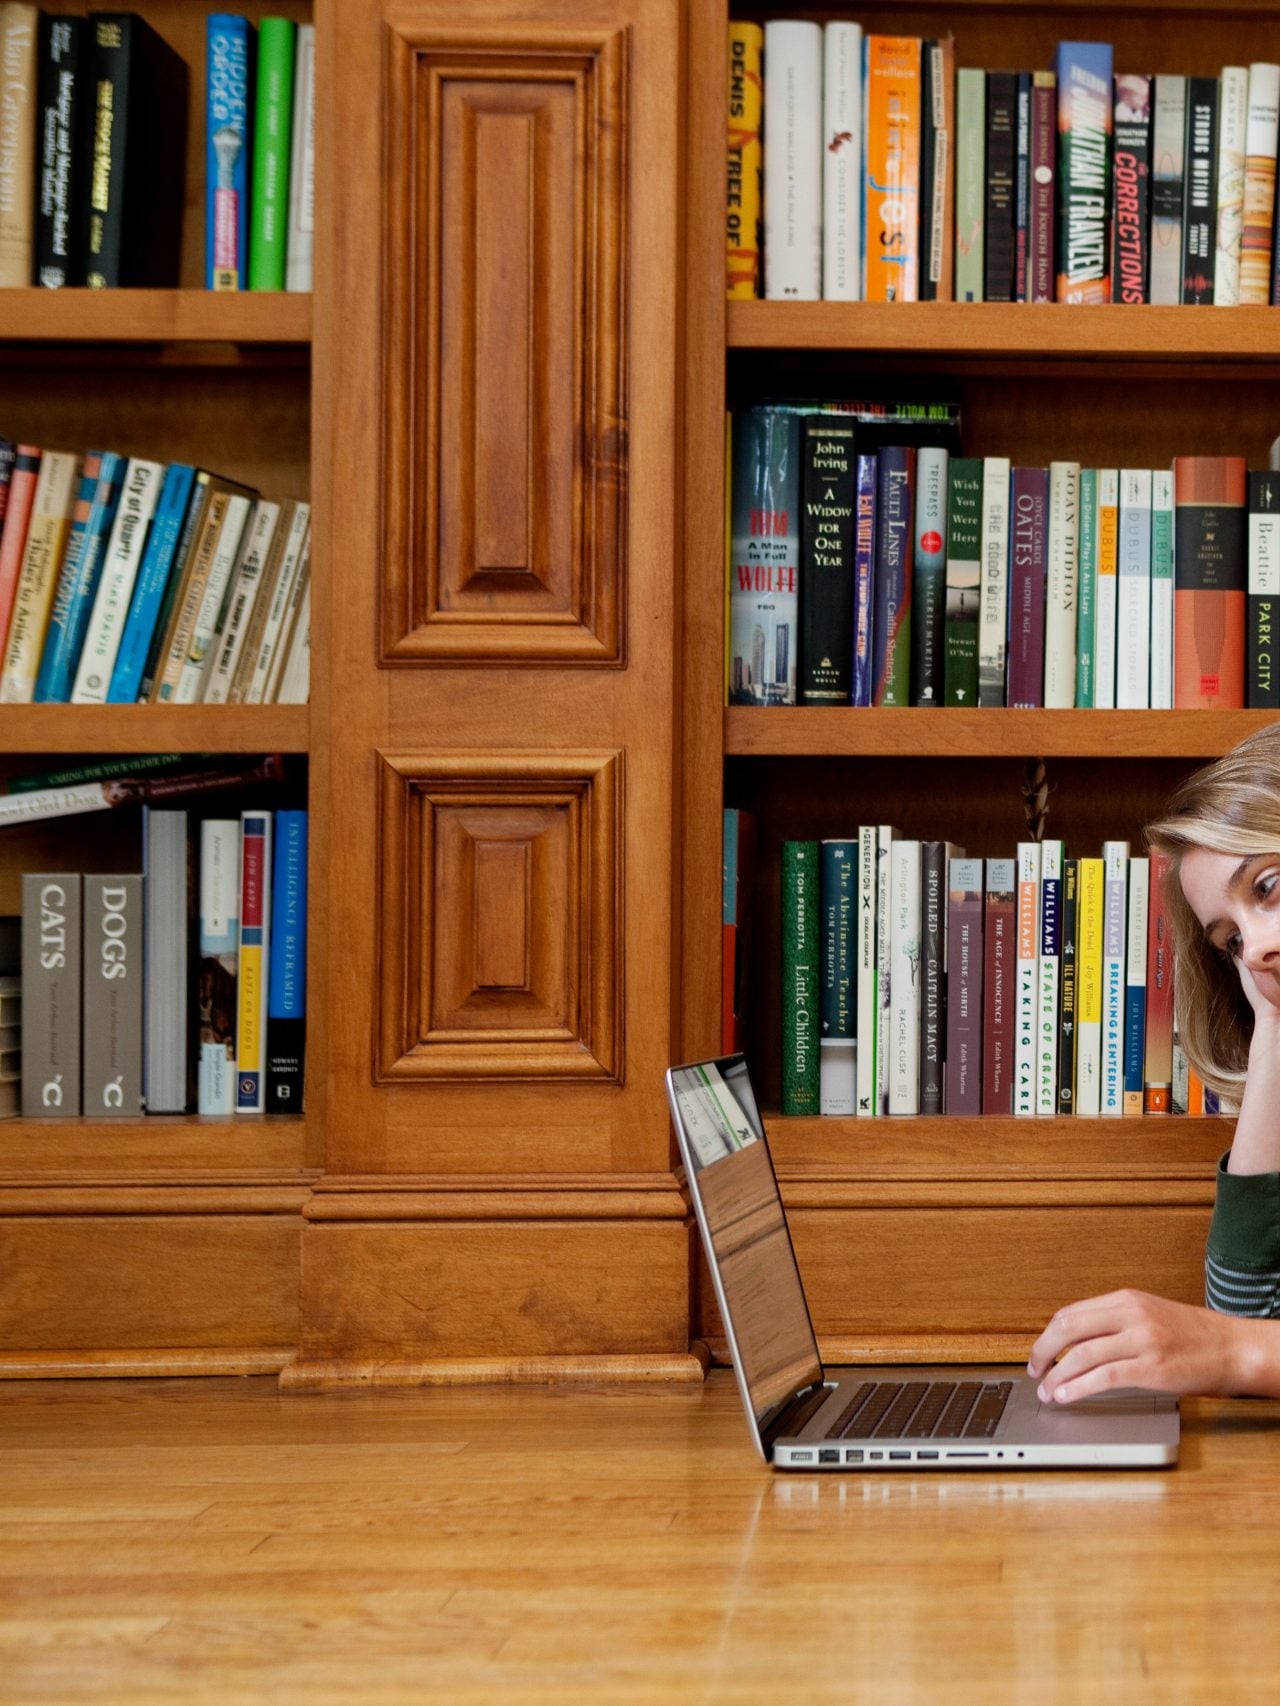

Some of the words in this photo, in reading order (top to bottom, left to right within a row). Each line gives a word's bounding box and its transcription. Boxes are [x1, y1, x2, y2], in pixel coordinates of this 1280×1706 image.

[731, 40, 745, 117] DENIS
[1038, 92, 1049, 123] JOHN
[1194, 105, 1210, 152] STRONG
[1039, 125, 1049, 163] IRVING
[1069, 87, 1106, 189] JONATHAN
[728, 147, 742, 207] TREE
[1038, 188, 1048, 207] THE
[1192, 159, 1209, 207] MOTION
[727, 214, 742, 247] OF
[1038, 212, 1048, 253] FOURTH
[1068, 195, 1104, 284] FRANZEN
[1116, 153, 1143, 304] CORRECTIONS
[1199, 223, 1208, 257] JONATHAN
[1038, 257, 1047, 290] HAND
[813, 457, 848, 472] Irving
[816, 442, 844, 454] John
[130, 467, 151, 493] City
[824, 489, 835, 500] A
[888, 470, 907, 517] FAULT
[927, 464, 939, 517] TRESPASS
[953, 480, 979, 490] Wish
[955, 497, 975, 507] You
[1065, 470, 1075, 524] JOAN
[129, 499, 143, 512] of
[807, 504, 852, 517] WIDOW
[953, 515, 978, 525] Were
[116, 515, 138, 559] Quartz
[814, 538, 842, 550] ONE
[818, 524, 840, 533] FOR
[887, 520, 906, 566] LINES
[952, 532, 978, 542] Here
[1016, 494, 1033, 566] OATES
[1101, 510, 1112, 574] DUBUS
[1129, 513, 1140, 573] DUBUS
[1156, 515, 1168, 574] DUBUS
[814, 554, 842, 567] YEAR
[1064, 536, 1074, 612] DIDION
[1258, 523, 1272, 588] Beattie
[52, 531, 84, 627] PHILOSOPHY
[109, 573, 124, 607] MIKE
[737, 566, 796, 592] WOLFE
[96, 614, 115, 655] DAVIS
[886, 601, 897, 635] Caitlin
[1258, 603, 1271, 644] PARK
[885, 639, 897, 686] Shetterly
[1258, 653, 1271, 691] CITY
[797, 872, 805, 894] TOM
[839, 863, 850, 889] The
[928, 870, 937, 932] SPOILED
[1023, 885, 1032, 958] WILLIAMS
[1045, 882, 1055, 954] WILLIAMS
[1109, 882, 1119, 954] WILLIAMS
[41, 884, 65, 969] CATS
[102, 886, 127, 979] DOGS
[797, 898, 805, 950] PERROTTA
[839, 895, 849, 970] Abstinence
[995, 918, 1003, 937] THE
[827, 932, 835, 988] PERROTTA
[1064, 964, 1073, 978] ILL
[1085, 965, 1093, 979] Joy
[795, 965, 810, 1005] Little
[838, 978, 848, 1032] Teacher
[927, 960, 937, 1020] CAITLIN
[994, 969, 1002, 1024] INNOCENCE
[1022, 969, 1031, 1045] TAKING
[1044, 963, 1053, 1012] STATE
[1063, 981, 1072, 1012] NATURE
[1085, 982, 1093, 1016] Williams
[1109, 963, 1119, 1028] BREAKING
[795, 1010, 810, 1073] Children
[898, 1009, 907, 1047] RACHEL
[927, 1024, 937, 1062] MACY
[1043, 1023, 1052, 1042] OF
[899, 1050, 907, 1074] CUSK
[1042, 1052, 1052, 1106] GRACE
[1107, 1043, 1118, 1106] ENTERING
[1020, 1062, 1030, 1111] CARE
